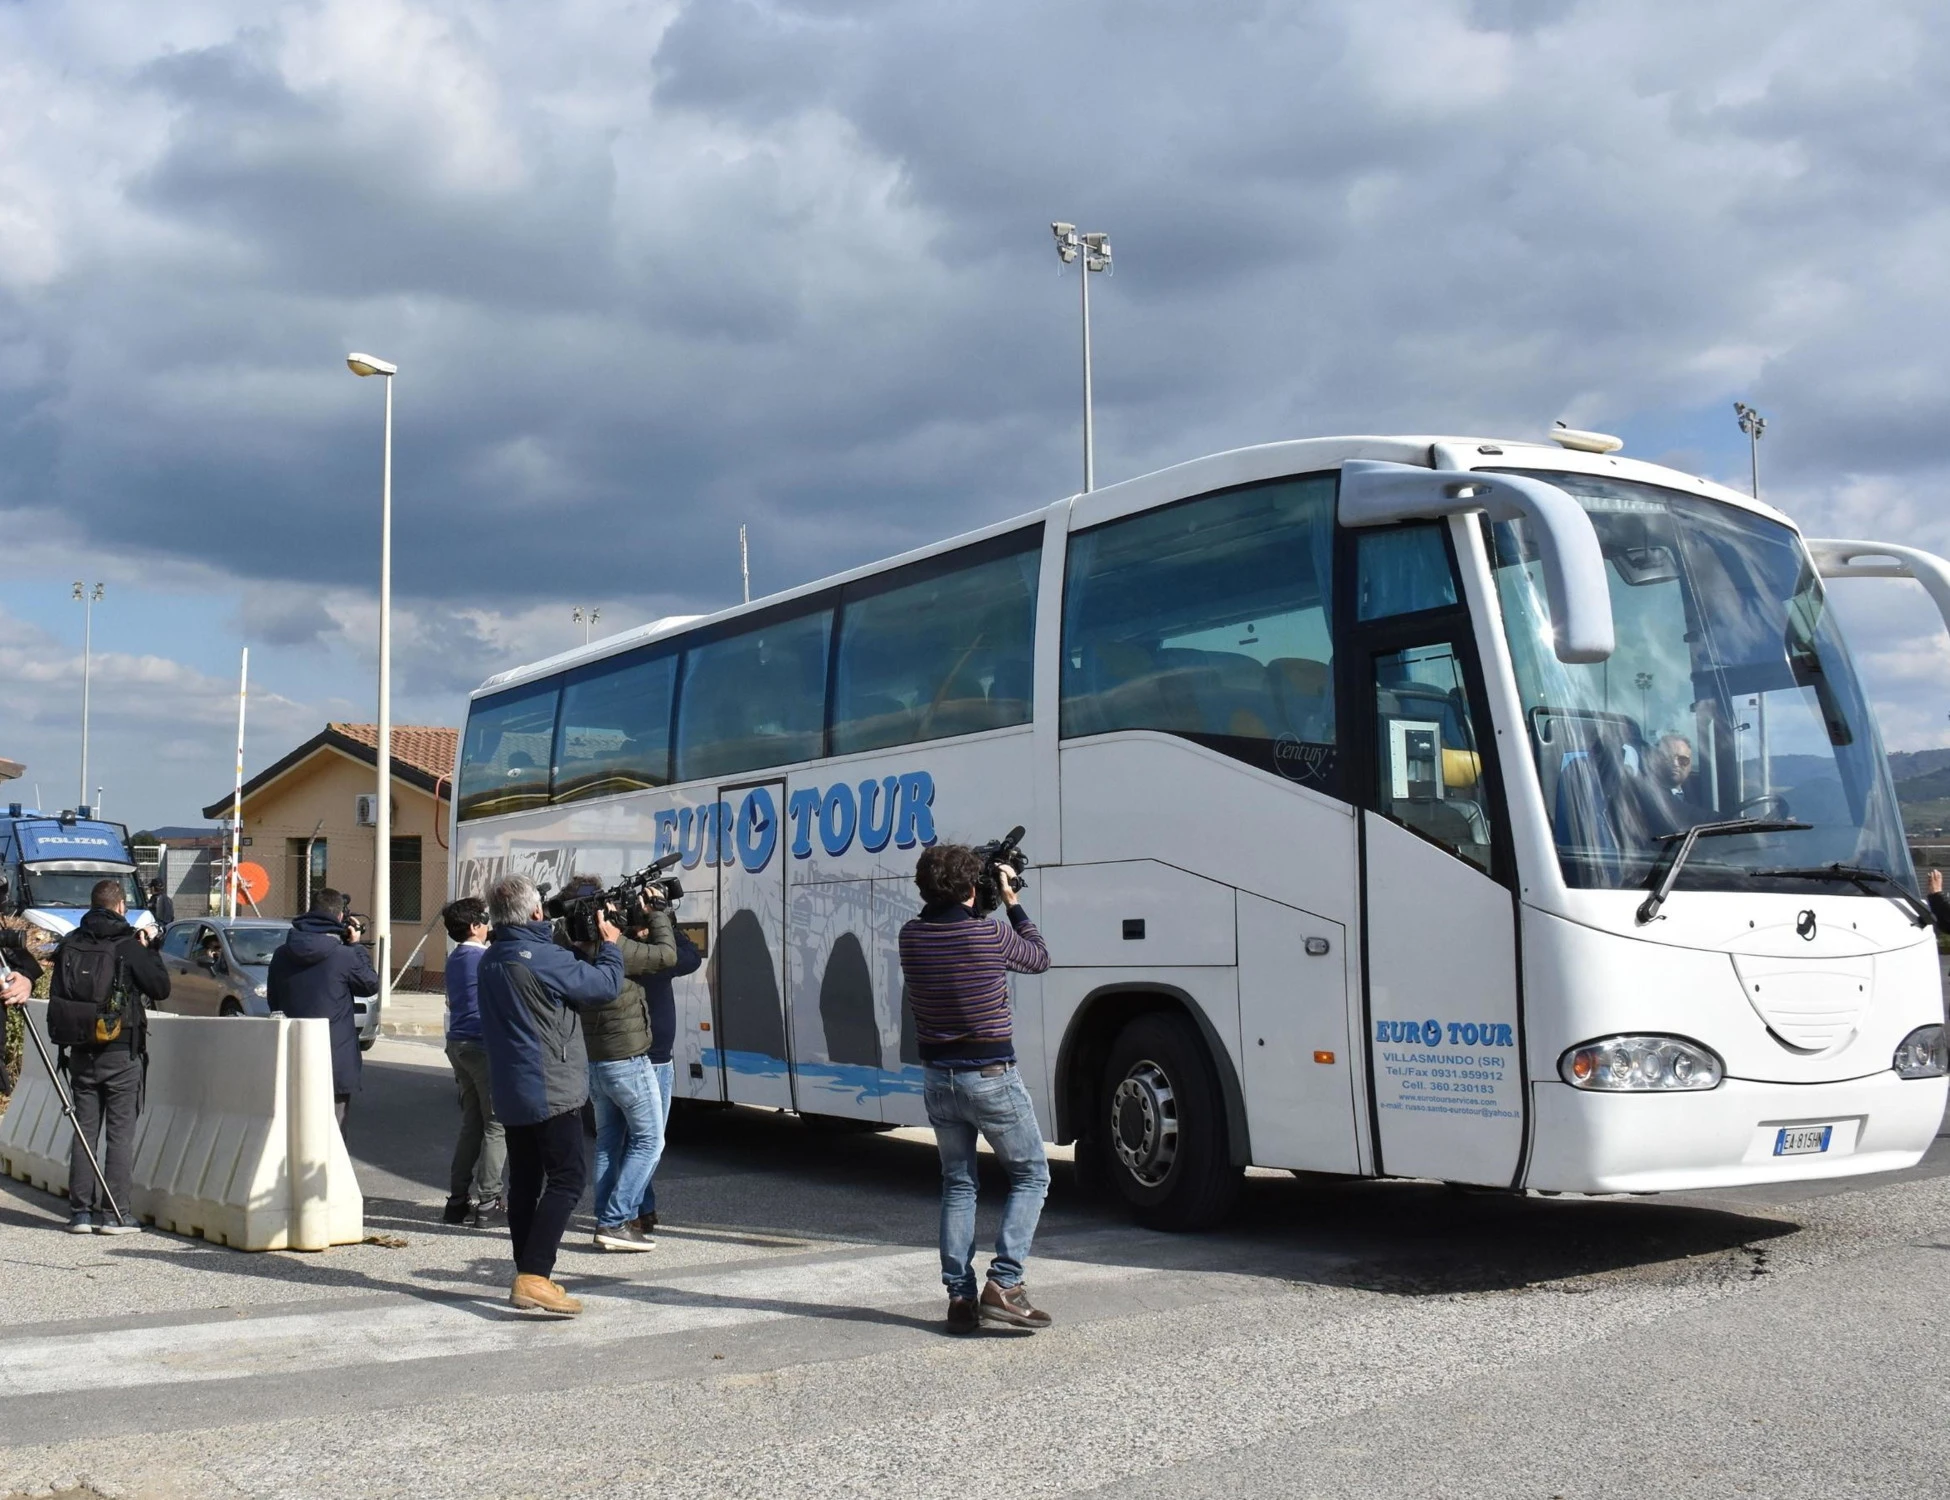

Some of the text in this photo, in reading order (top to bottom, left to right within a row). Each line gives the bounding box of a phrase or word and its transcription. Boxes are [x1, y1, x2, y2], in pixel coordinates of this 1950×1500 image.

[1275, 738, 1328, 768] Century
[653, 771, 938, 874] EURO TOUR
[38, 836, 108, 846] POLIZIA
[1376, 1019, 1514, 1047] EURO TOUR
[1383, 1052, 1505, 1068] VILLASMUNDO (SR)
[1431, 1069, 1503, 1081] 0931.959912
[1402, 1080, 1494, 1094] Cell. 360.230183
[1399, 1094, 1497, 1106] www.eurotourservices.com
